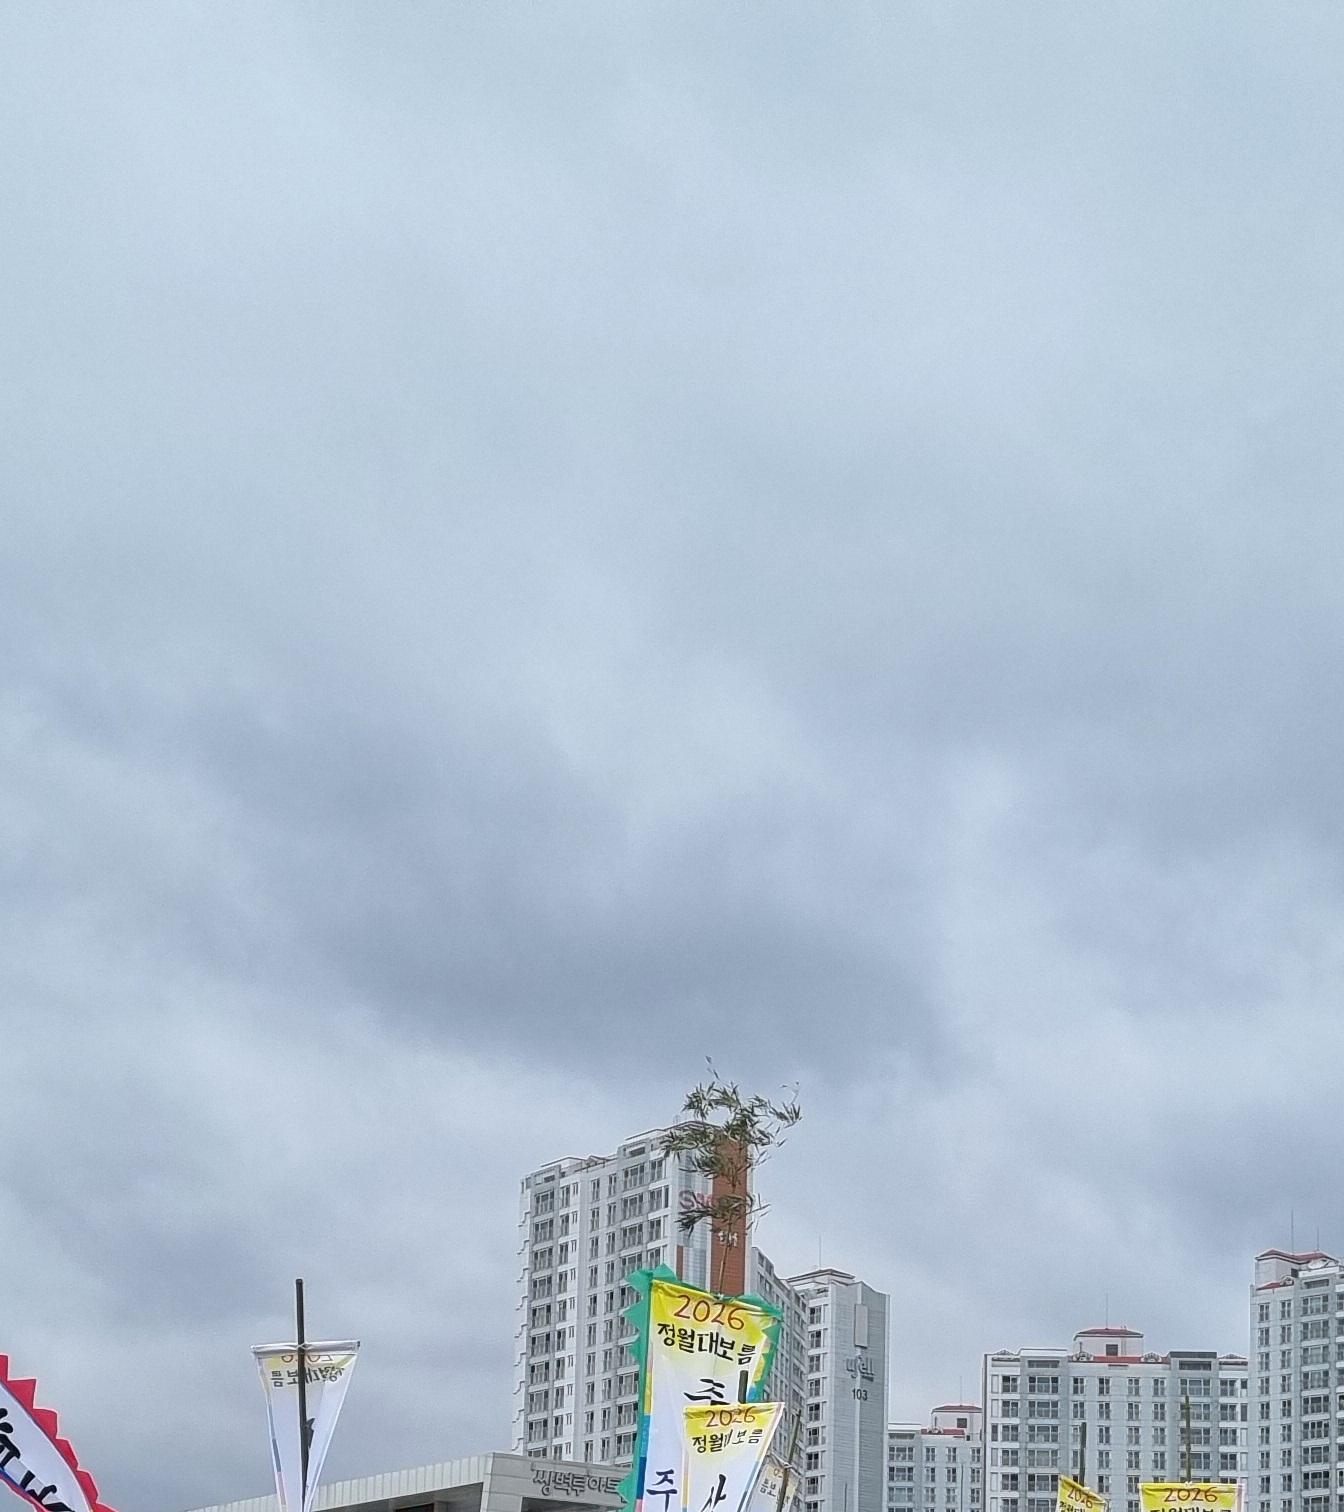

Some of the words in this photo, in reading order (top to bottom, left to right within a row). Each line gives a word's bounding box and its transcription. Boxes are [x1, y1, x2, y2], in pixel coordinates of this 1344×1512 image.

[674, 1294, 745, 1331] 2026
[657, 1323, 757, 1366] 정월대보름
[851, 1388, 868, 1401] 103
[705, 1405, 757, 1428] 2026
[692, 1428, 763, 1454] 정월보름
[1067, 1488, 1094, 1509] 2026
[1164, 1486, 1218, 1503] 2026
